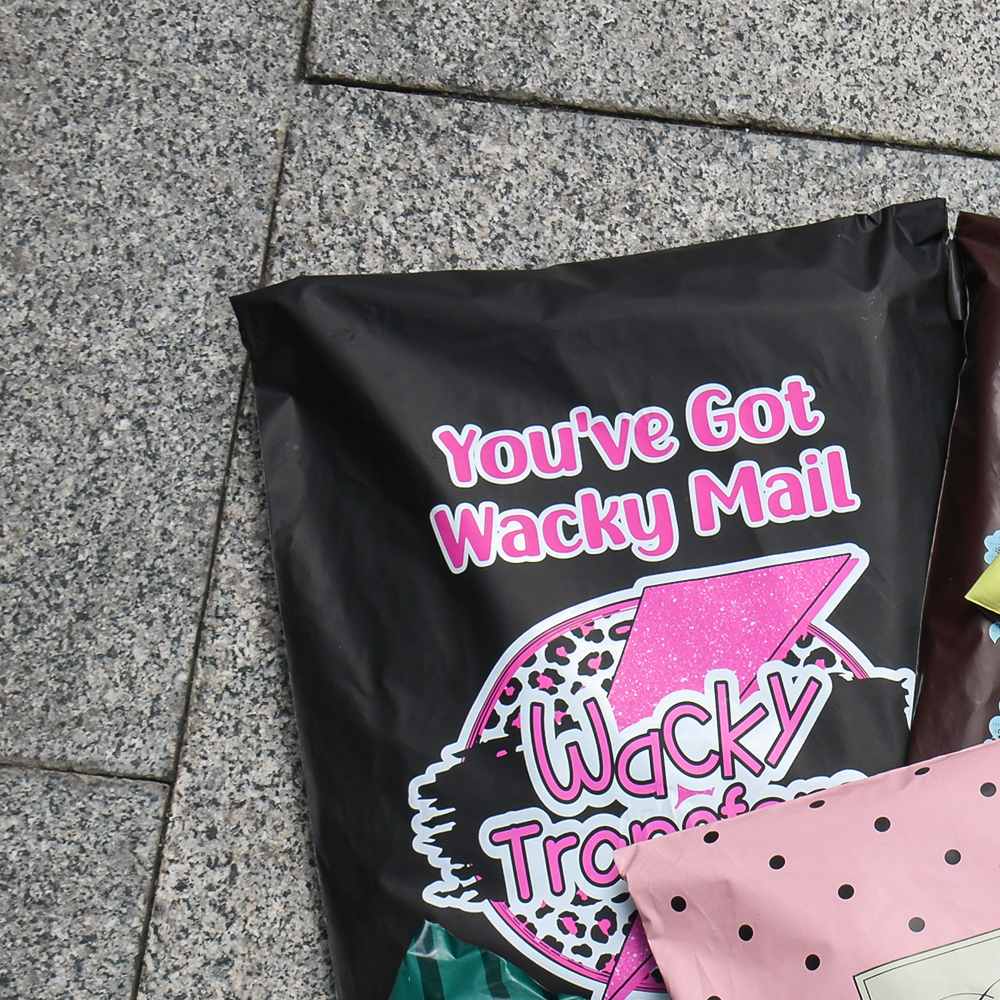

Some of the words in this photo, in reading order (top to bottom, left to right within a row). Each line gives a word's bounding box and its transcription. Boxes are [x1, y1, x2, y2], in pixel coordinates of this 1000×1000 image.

[435, 408, 679, 486] You've
[688, 378, 823, 449] Got
[432, 490, 677, 571] Wacky
[690, 448, 858, 533] Mail
[529, 671, 823, 803] Wacky
